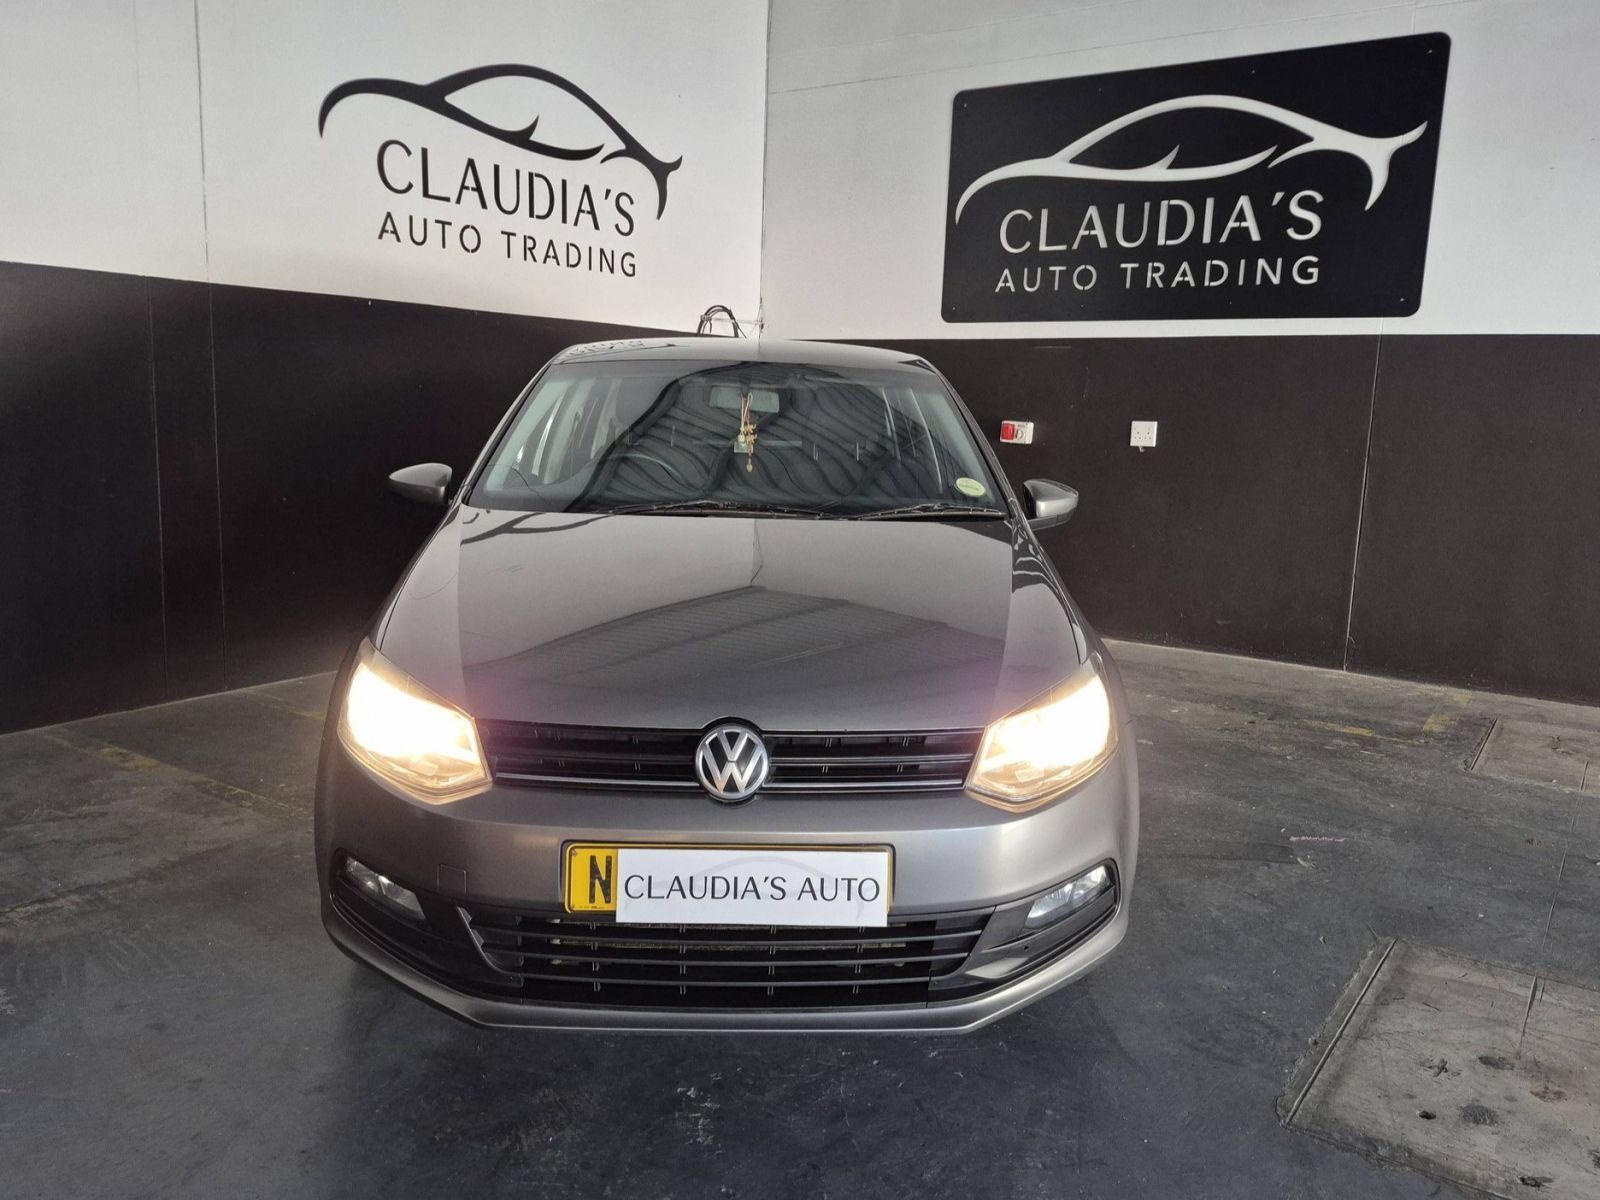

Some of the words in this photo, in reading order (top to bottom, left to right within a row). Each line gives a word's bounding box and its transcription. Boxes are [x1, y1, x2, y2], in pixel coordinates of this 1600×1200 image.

[378, 211, 481, 254] AUTO
[500, 230, 636, 277] TRADING
[995, 265, 1097, 293] AUTO
[1120, 256, 1319, 289] TRADING
[589, 855, 612, 904] N
[797, 877, 880, 902] AUTO
